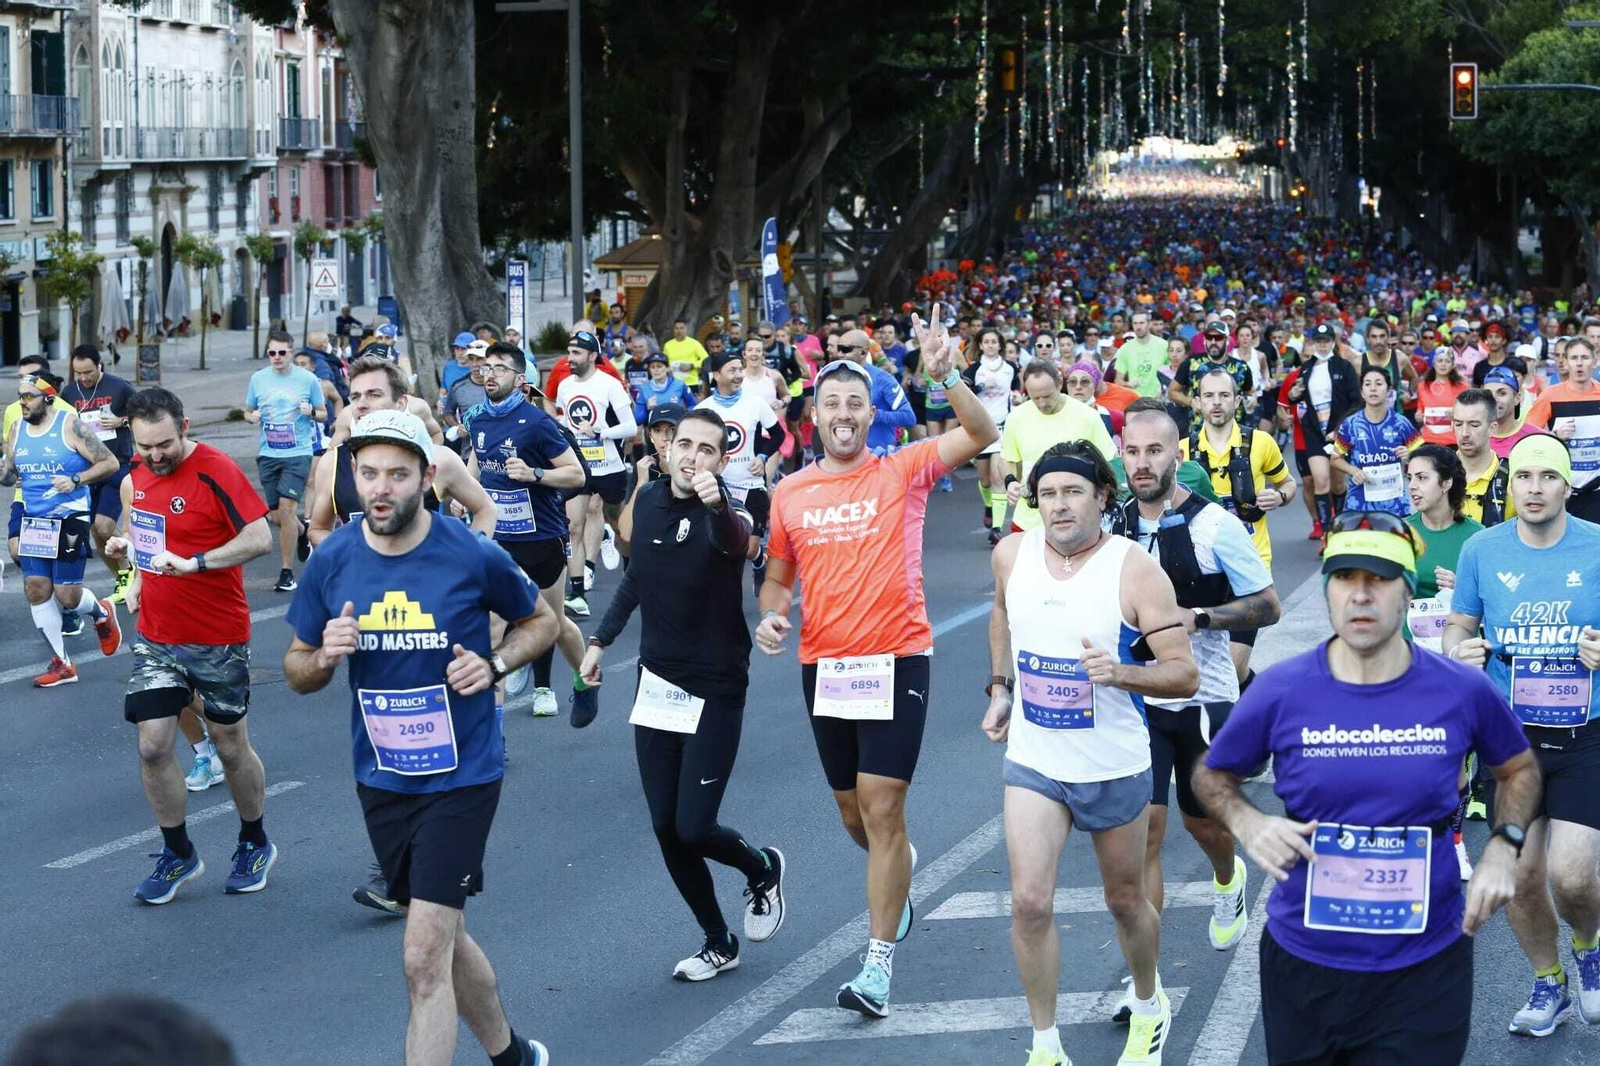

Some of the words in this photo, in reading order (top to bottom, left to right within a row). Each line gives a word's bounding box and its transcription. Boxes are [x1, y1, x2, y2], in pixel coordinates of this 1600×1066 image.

[509, 265, 523, 276] BUS
[503, 506, 523, 515] 3685
[802, 498, 879, 529] NACEX
[137, 515, 157, 525] ZURICH
[139, 533, 157, 545] 2550
[1510, 600, 1571, 626] 42K
[382, 631, 449, 651] MASTERS
[1505, 645, 1516, 654] WE
[1517, 646, 1532, 655] ARE
[1532, 645, 1576, 655] MARATHON
[847, 662, 878, 670] ZURICH
[1041, 662, 1076, 672] ZURICH
[1544, 664, 1576, 672] ZURICH
[851, 680, 880, 690] 6894
[1548, 685, 1579, 695] 2580
[665, 689, 692, 703] 8901
[1046, 685, 1079, 698] 2405
[389, 696, 427, 707] ZURICH
[399, 721, 435, 735] 2490
[1301, 723, 1447, 745] todocoleccion
[1302, 747, 1337, 758] DONDE
[1338, 747, 1367, 757] VIVEN
[1369, 746, 1389, 757] LOS
[1389, 745, 1447, 755] RECUERDOS
[1358, 837, 1405, 848] ZURICH
[1364, 869, 1408, 883] 2337
